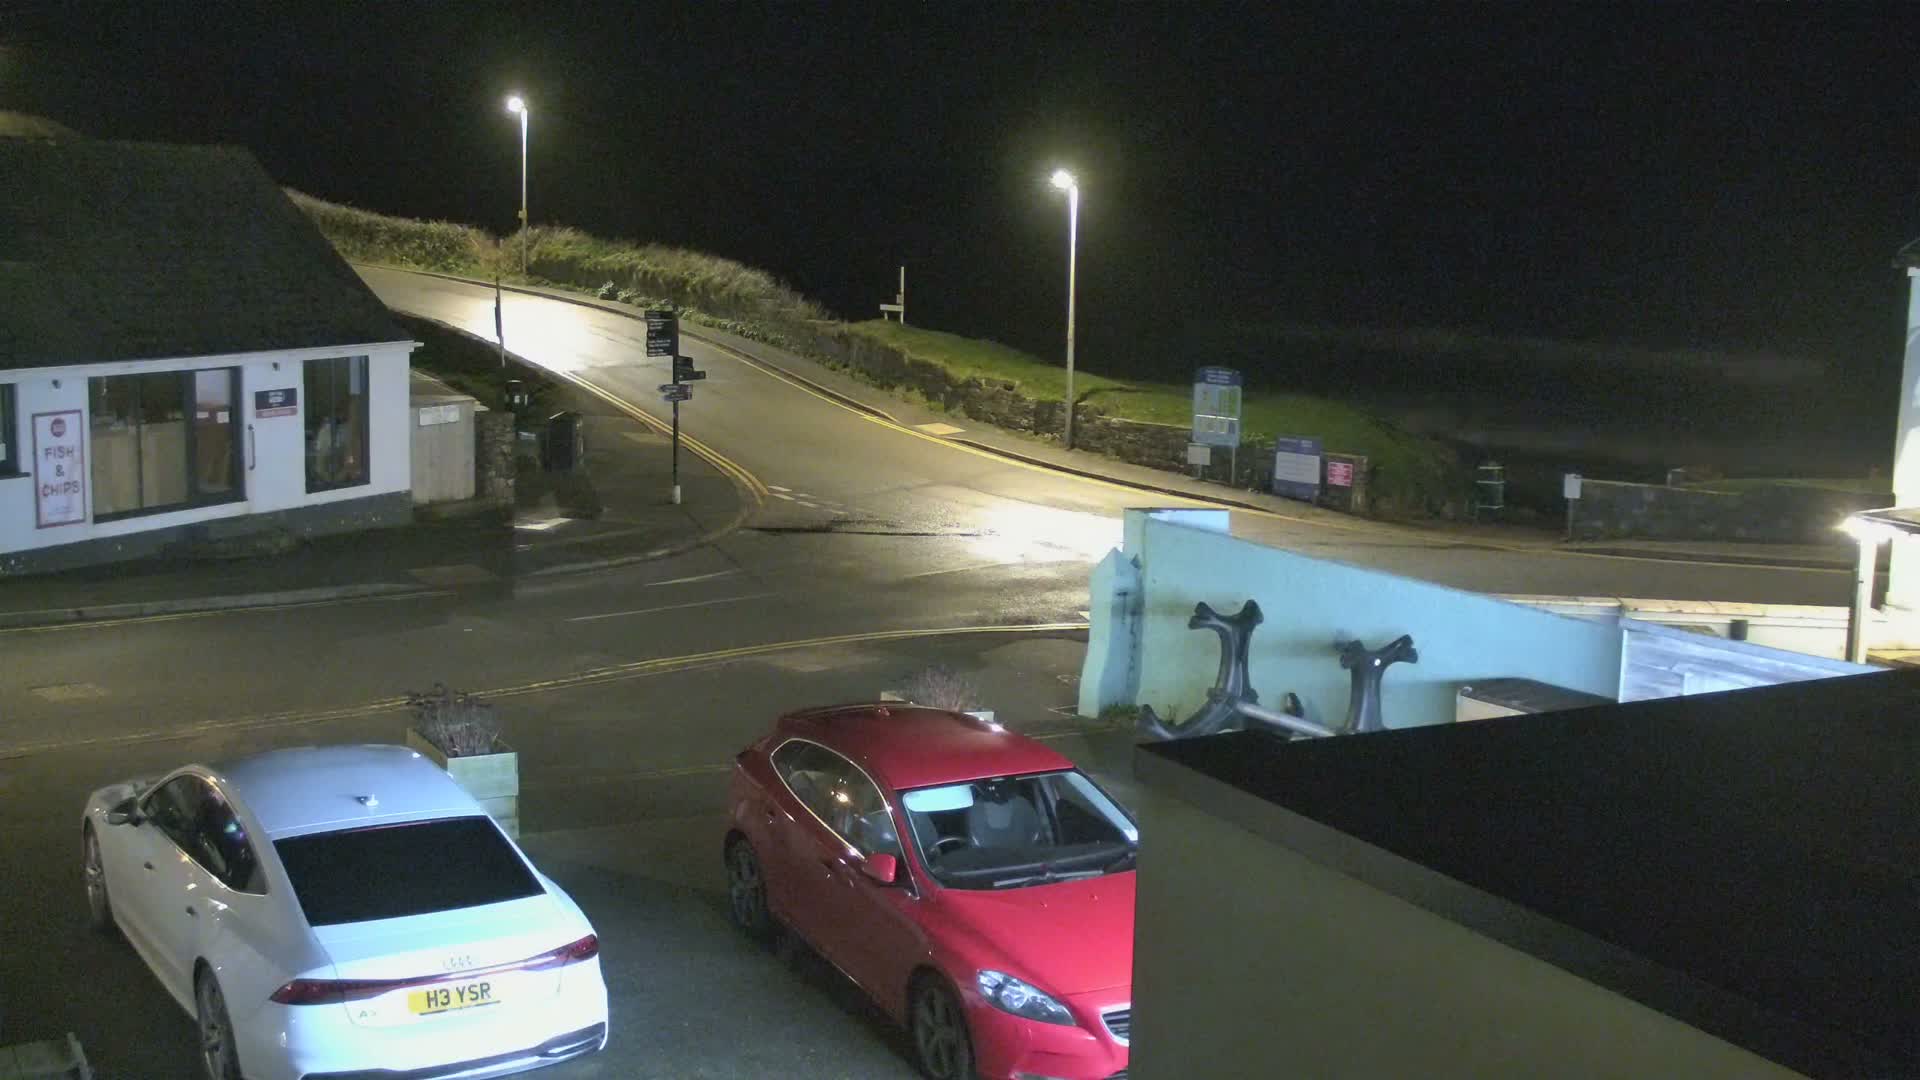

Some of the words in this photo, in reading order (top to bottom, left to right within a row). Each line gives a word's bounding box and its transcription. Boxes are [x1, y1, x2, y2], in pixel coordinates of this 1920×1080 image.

[45, 446, 74, 460] FISH
[56, 464, 65, 477] &
[42, 480, 80, 497] CHIPS
[426, 987, 451, 1009] H3
[456, 982, 492, 1003] YSR
